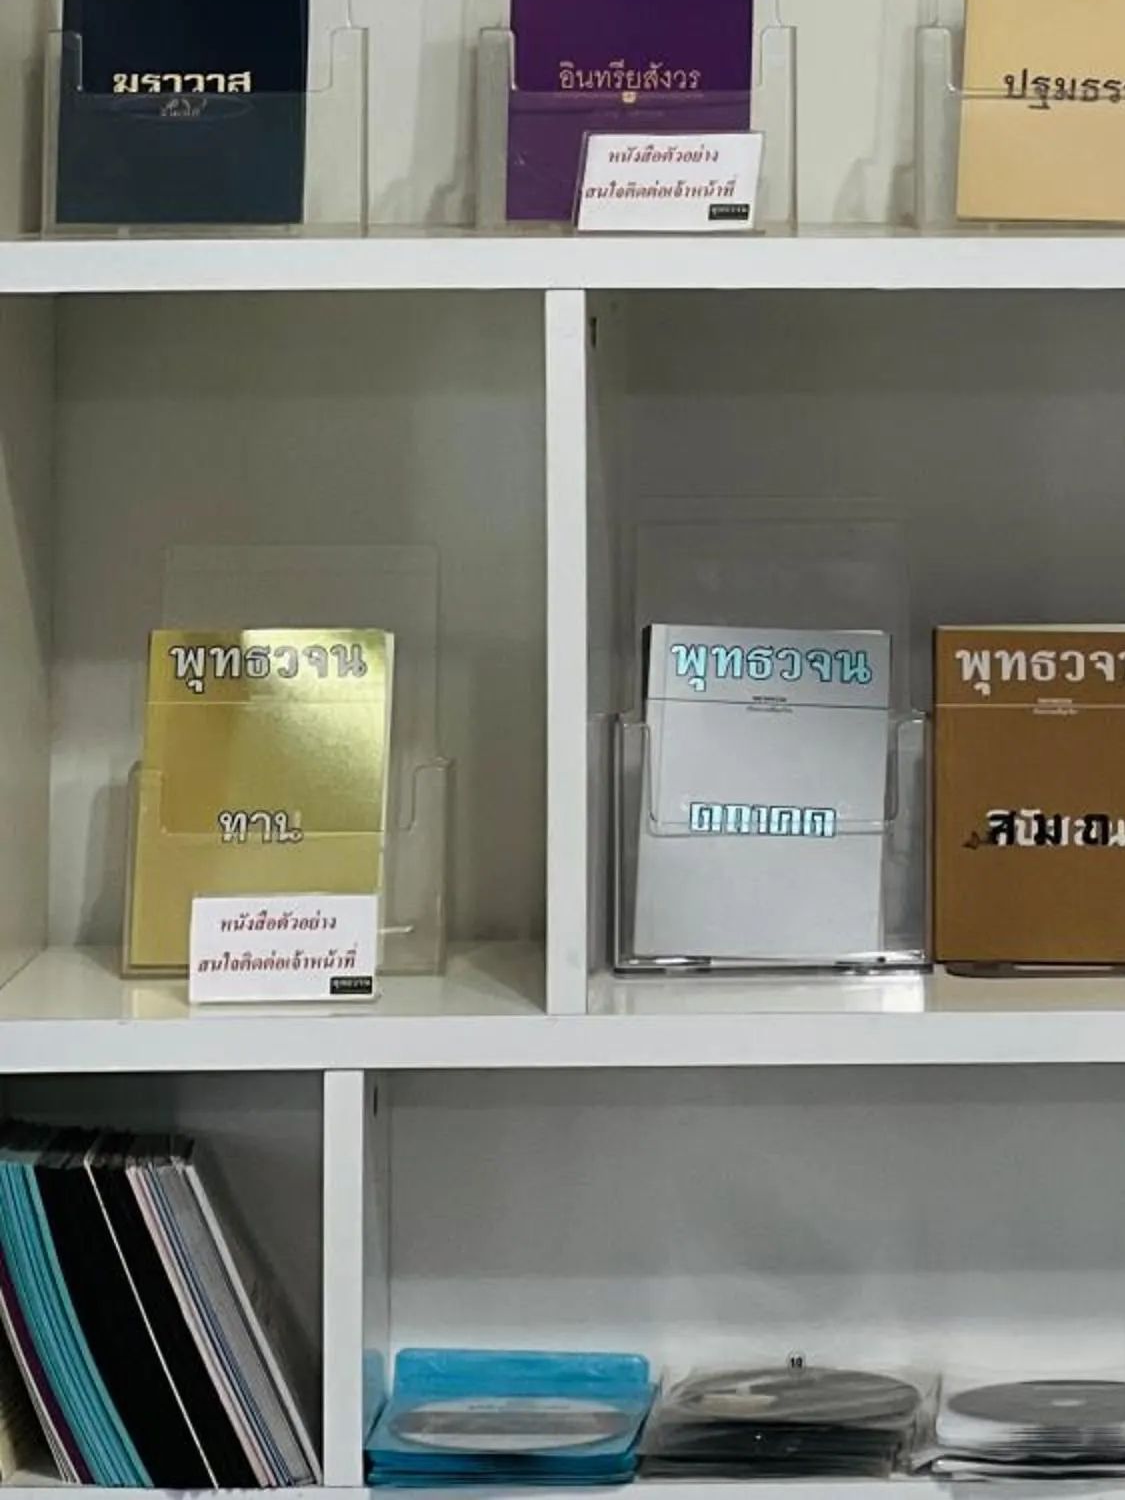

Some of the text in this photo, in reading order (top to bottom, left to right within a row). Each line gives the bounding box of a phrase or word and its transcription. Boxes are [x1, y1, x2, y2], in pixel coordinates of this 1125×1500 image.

[171, 642, 367, 694] พุทธวจน
[671, 643, 873, 692] พุทธวจน
[219, 810, 303, 843] ทาน
